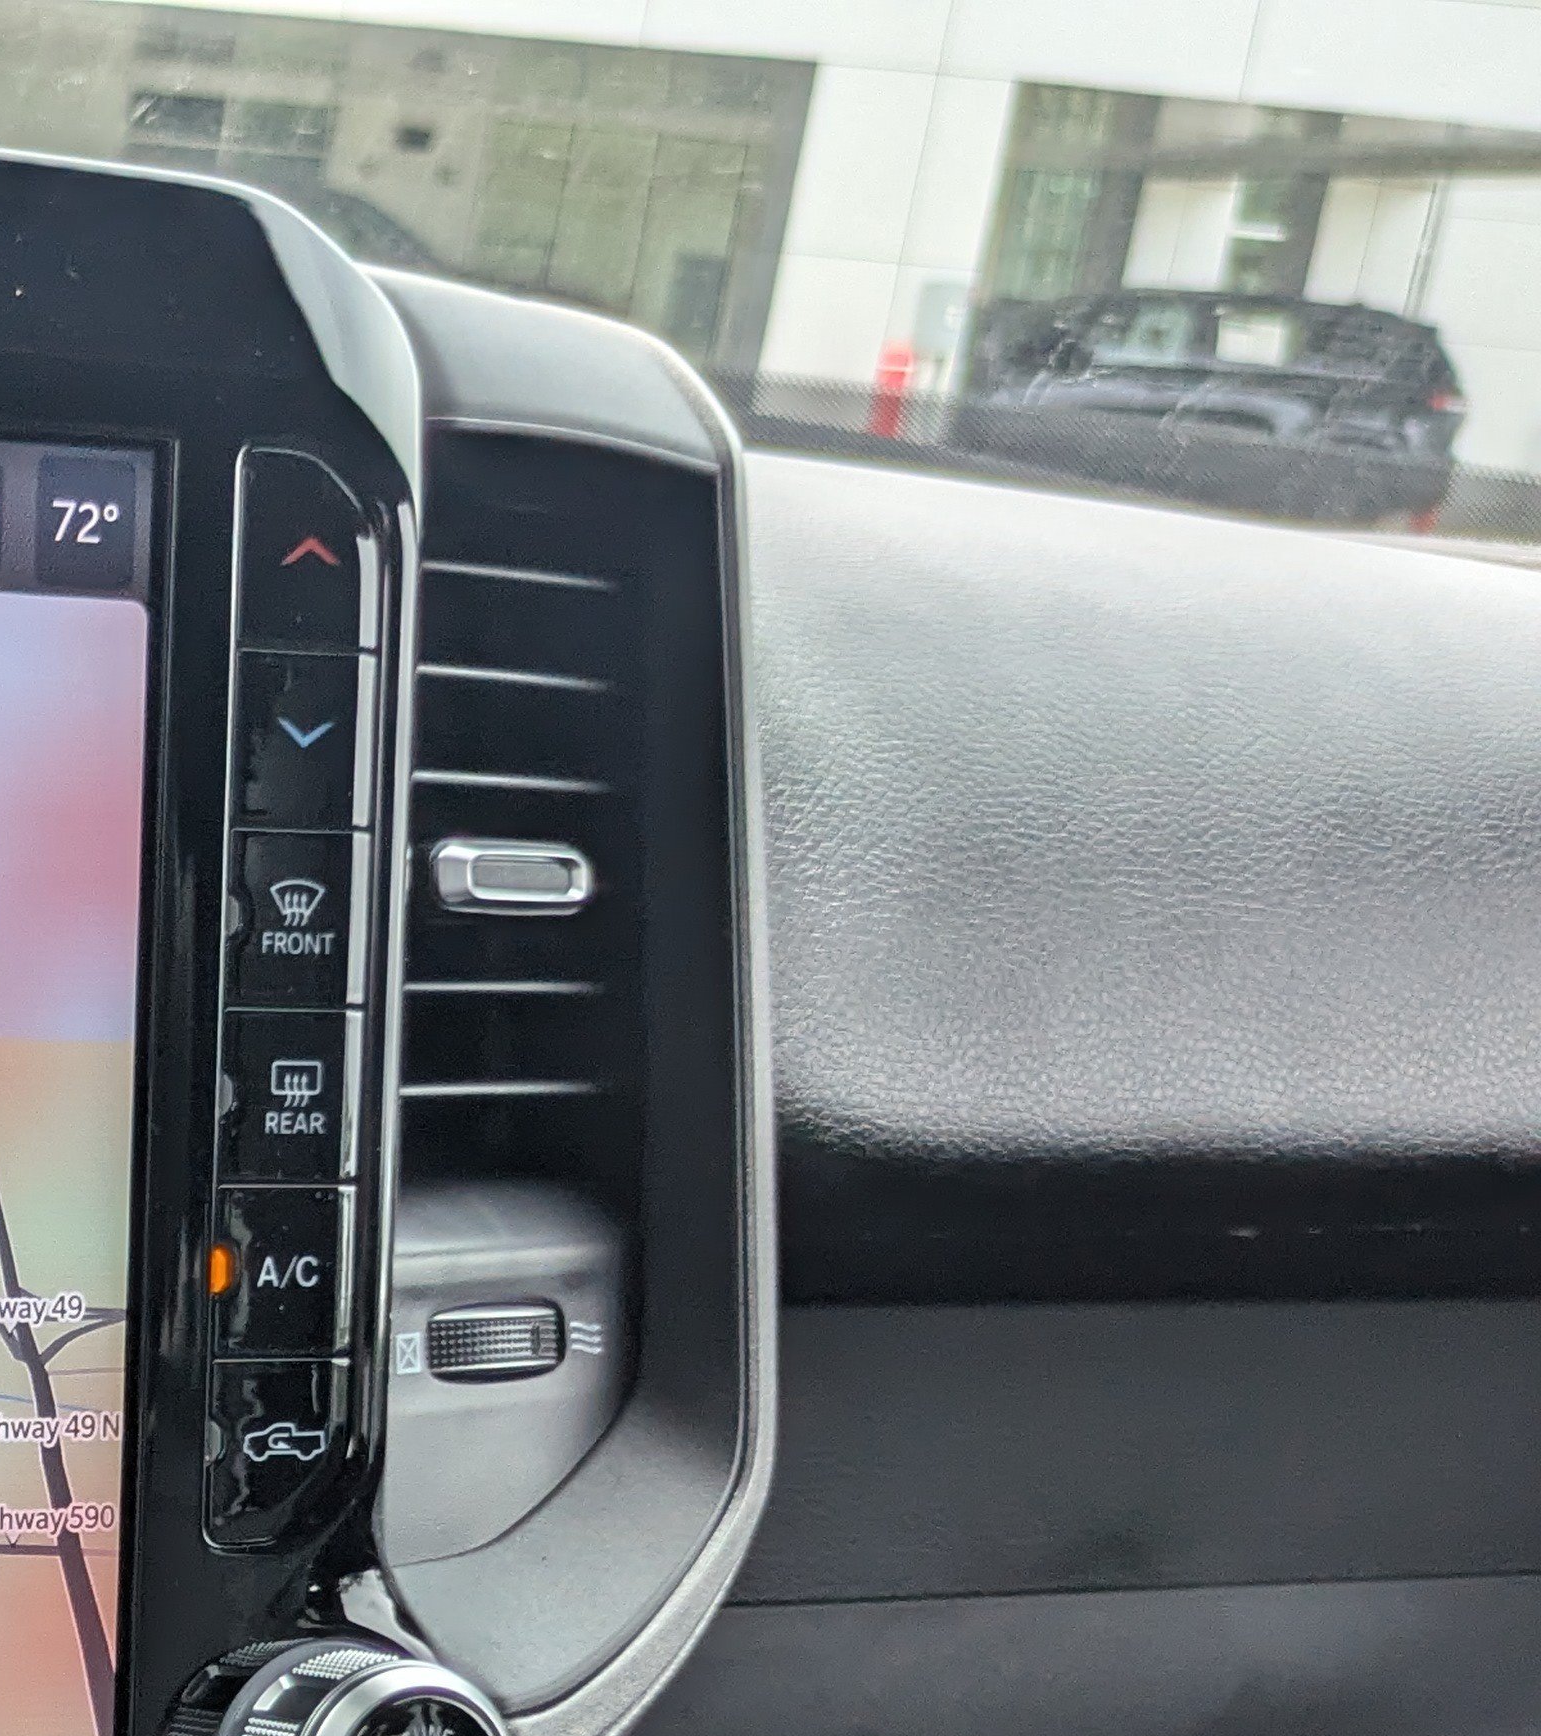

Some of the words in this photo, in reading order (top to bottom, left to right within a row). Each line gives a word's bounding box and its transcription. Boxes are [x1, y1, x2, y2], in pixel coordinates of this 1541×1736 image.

[52, 500, 120, 545] 72°
[261, 932, 335, 956] FRONT
[265, 1112, 327, 1135] REAR
[257, 1256, 320, 1288] A/C
[51, 1295, 83, 1320] 49
[65, 1414, 95, 1438] 49
[103, 1414, 119, 1438] N
[70, 1505, 114, 1529] 590
